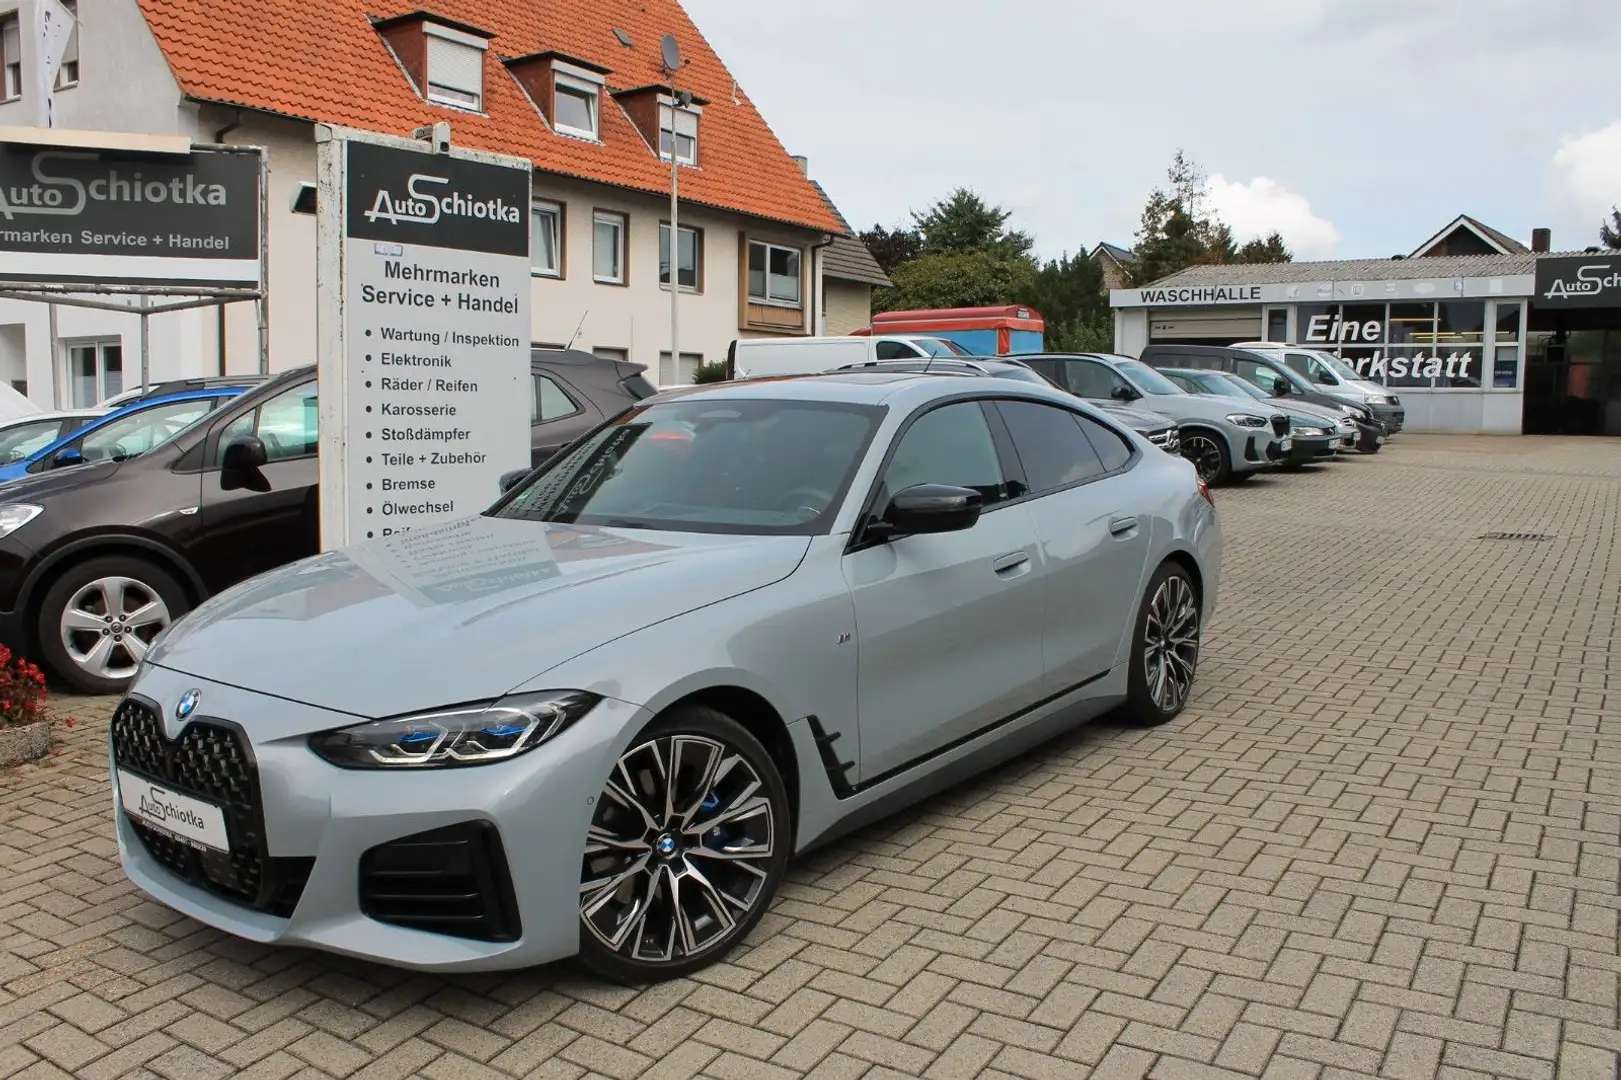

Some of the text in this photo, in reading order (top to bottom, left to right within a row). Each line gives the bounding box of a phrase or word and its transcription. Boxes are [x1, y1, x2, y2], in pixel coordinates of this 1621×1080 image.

[81, 230, 148, 246] Service
[153, 234, 163, 245] +
[169, 233, 229, 250] Handel
[385, 260, 500, 288] Mehrmarken
[362, 284, 518, 314] Service + Handel
[1140, 286, 1261, 303] WASCHHALLE
[1306, 314, 1381, 341] Eine
[381, 327, 440, 345] Wartung
[452, 331, 519, 347] Inspektion
[381, 352, 452, 367] Elektronik
[381, 377, 424, 391] Räder
[435, 379, 478, 392] Reifen
[381, 403, 457, 416] Karosserie
[381, 427, 471, 443] Stoßdämpfer
[381, 452, 486, 465] Teile + Zubehör
[382, 478, 436, 491] Bremse
[382, 500, 454, 516] Ölwechsel
